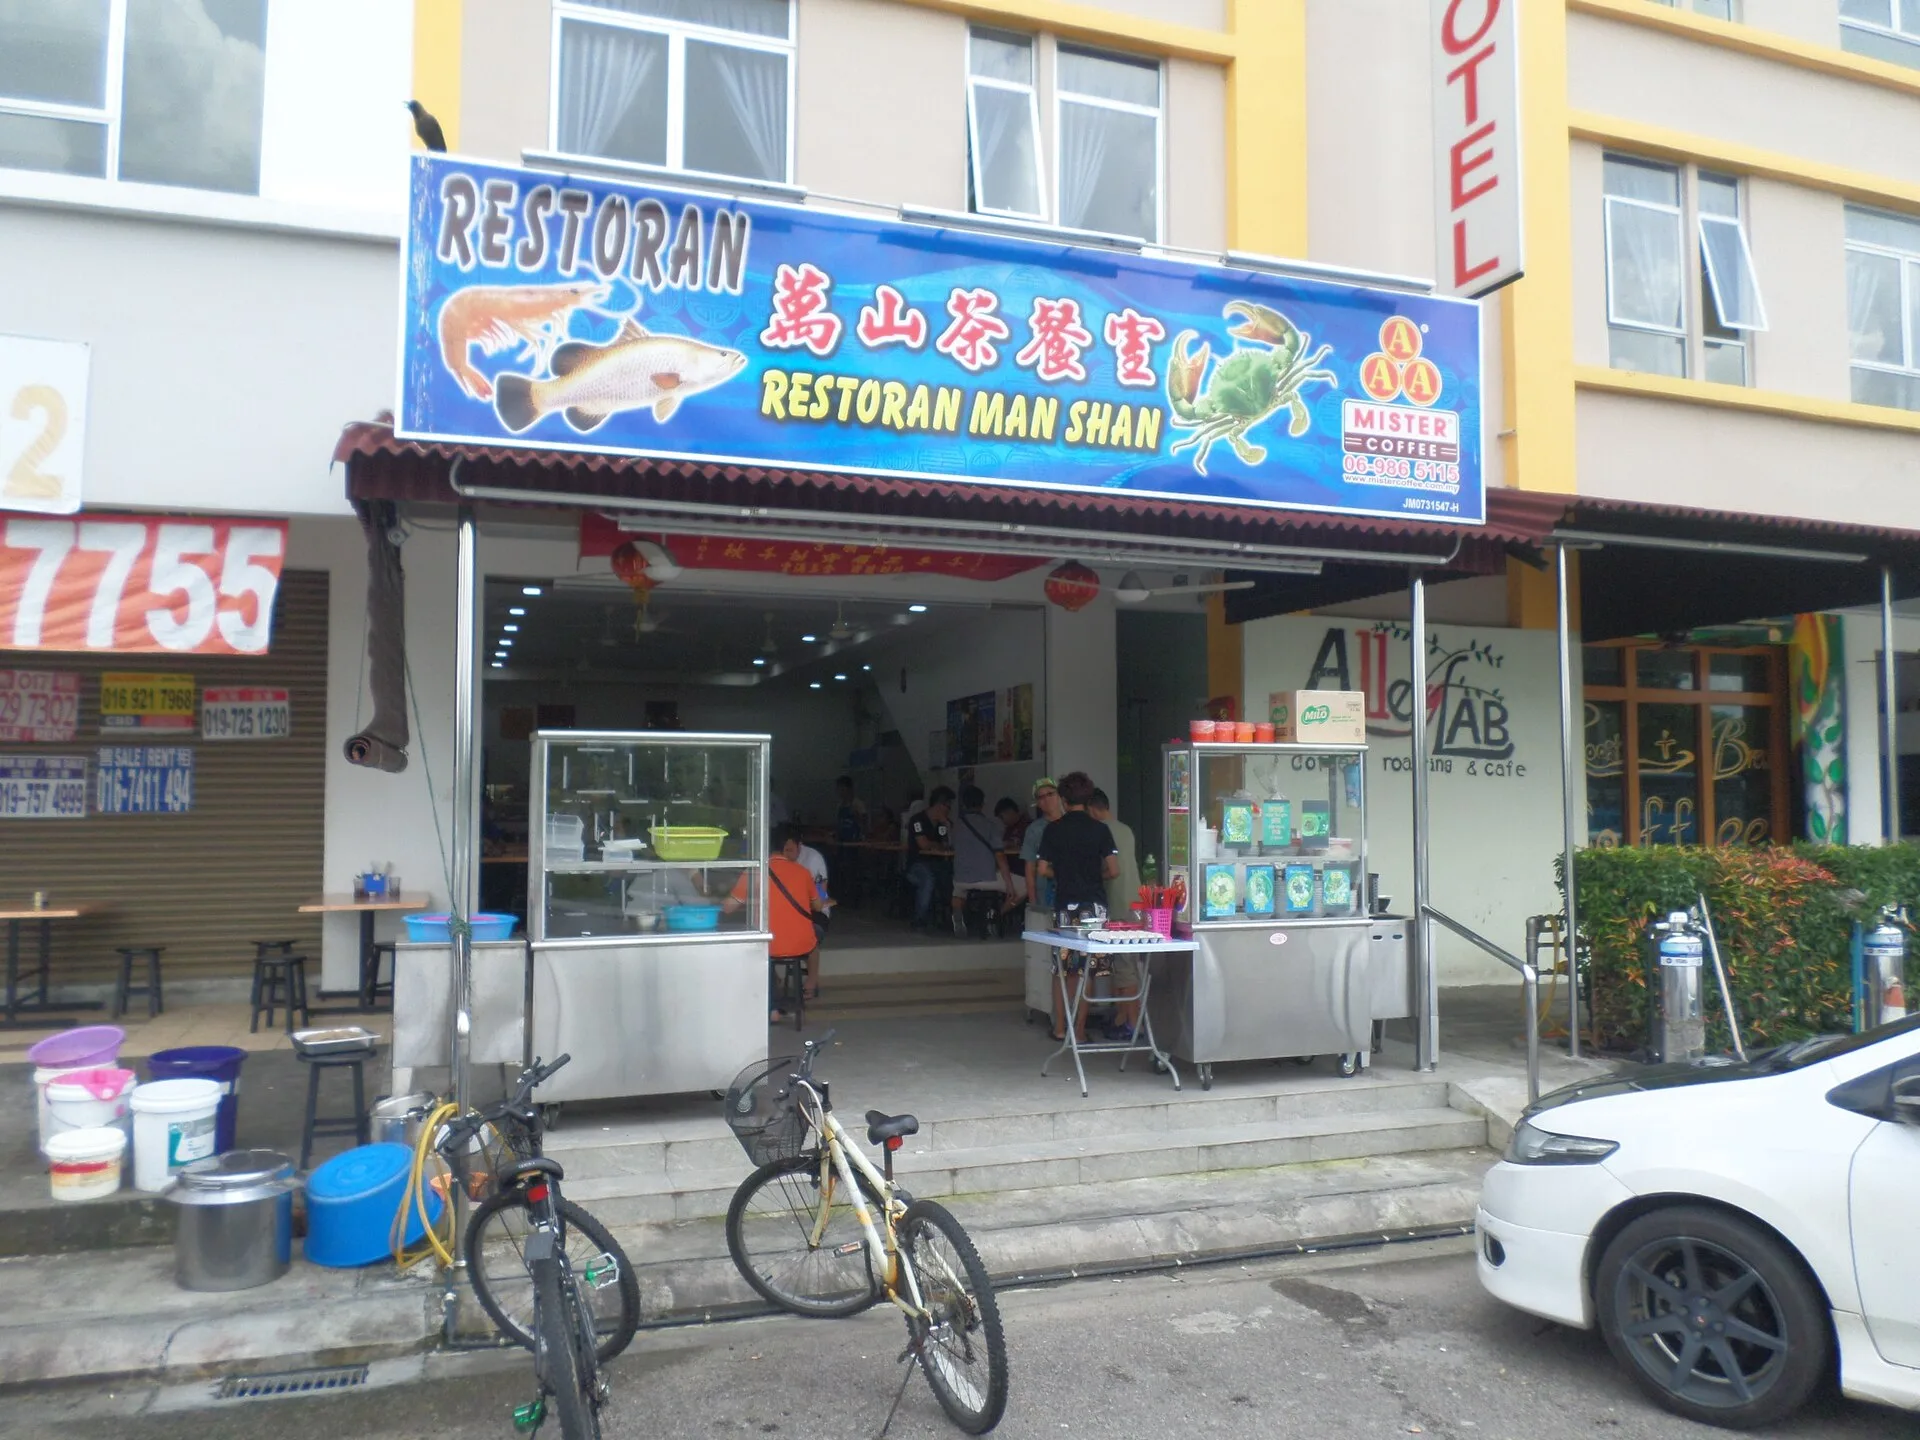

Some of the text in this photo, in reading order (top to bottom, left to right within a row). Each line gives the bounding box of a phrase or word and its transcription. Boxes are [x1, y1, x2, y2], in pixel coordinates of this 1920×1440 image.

[439, 172, 751, 297] RESTORAN
[761, 368, 1162, 449] RESTORAN MAN SHAN
[1354, 407, 1447, 438] MISTER
[3, 384, 68, 498] 2
[1366, 437, 1437, 457] COFFEE
[1343, 455, 1460, 483] 06-986 5115
[1344, 472, 1459, 494] www.mistercoffee.com.my
[5, 518, 284, 651] 7755
[131, 688, 155, 709] 921
[160, 688, 193, 710] 7968
[204, 706, 288, 736] 019-725 1230
[115, 748, 142, 767] SALE
[148, 748, 175, 767] RENT
[1382, 754, 1452, 774] roaing
[1483, 759, 1527, 777] cafe
